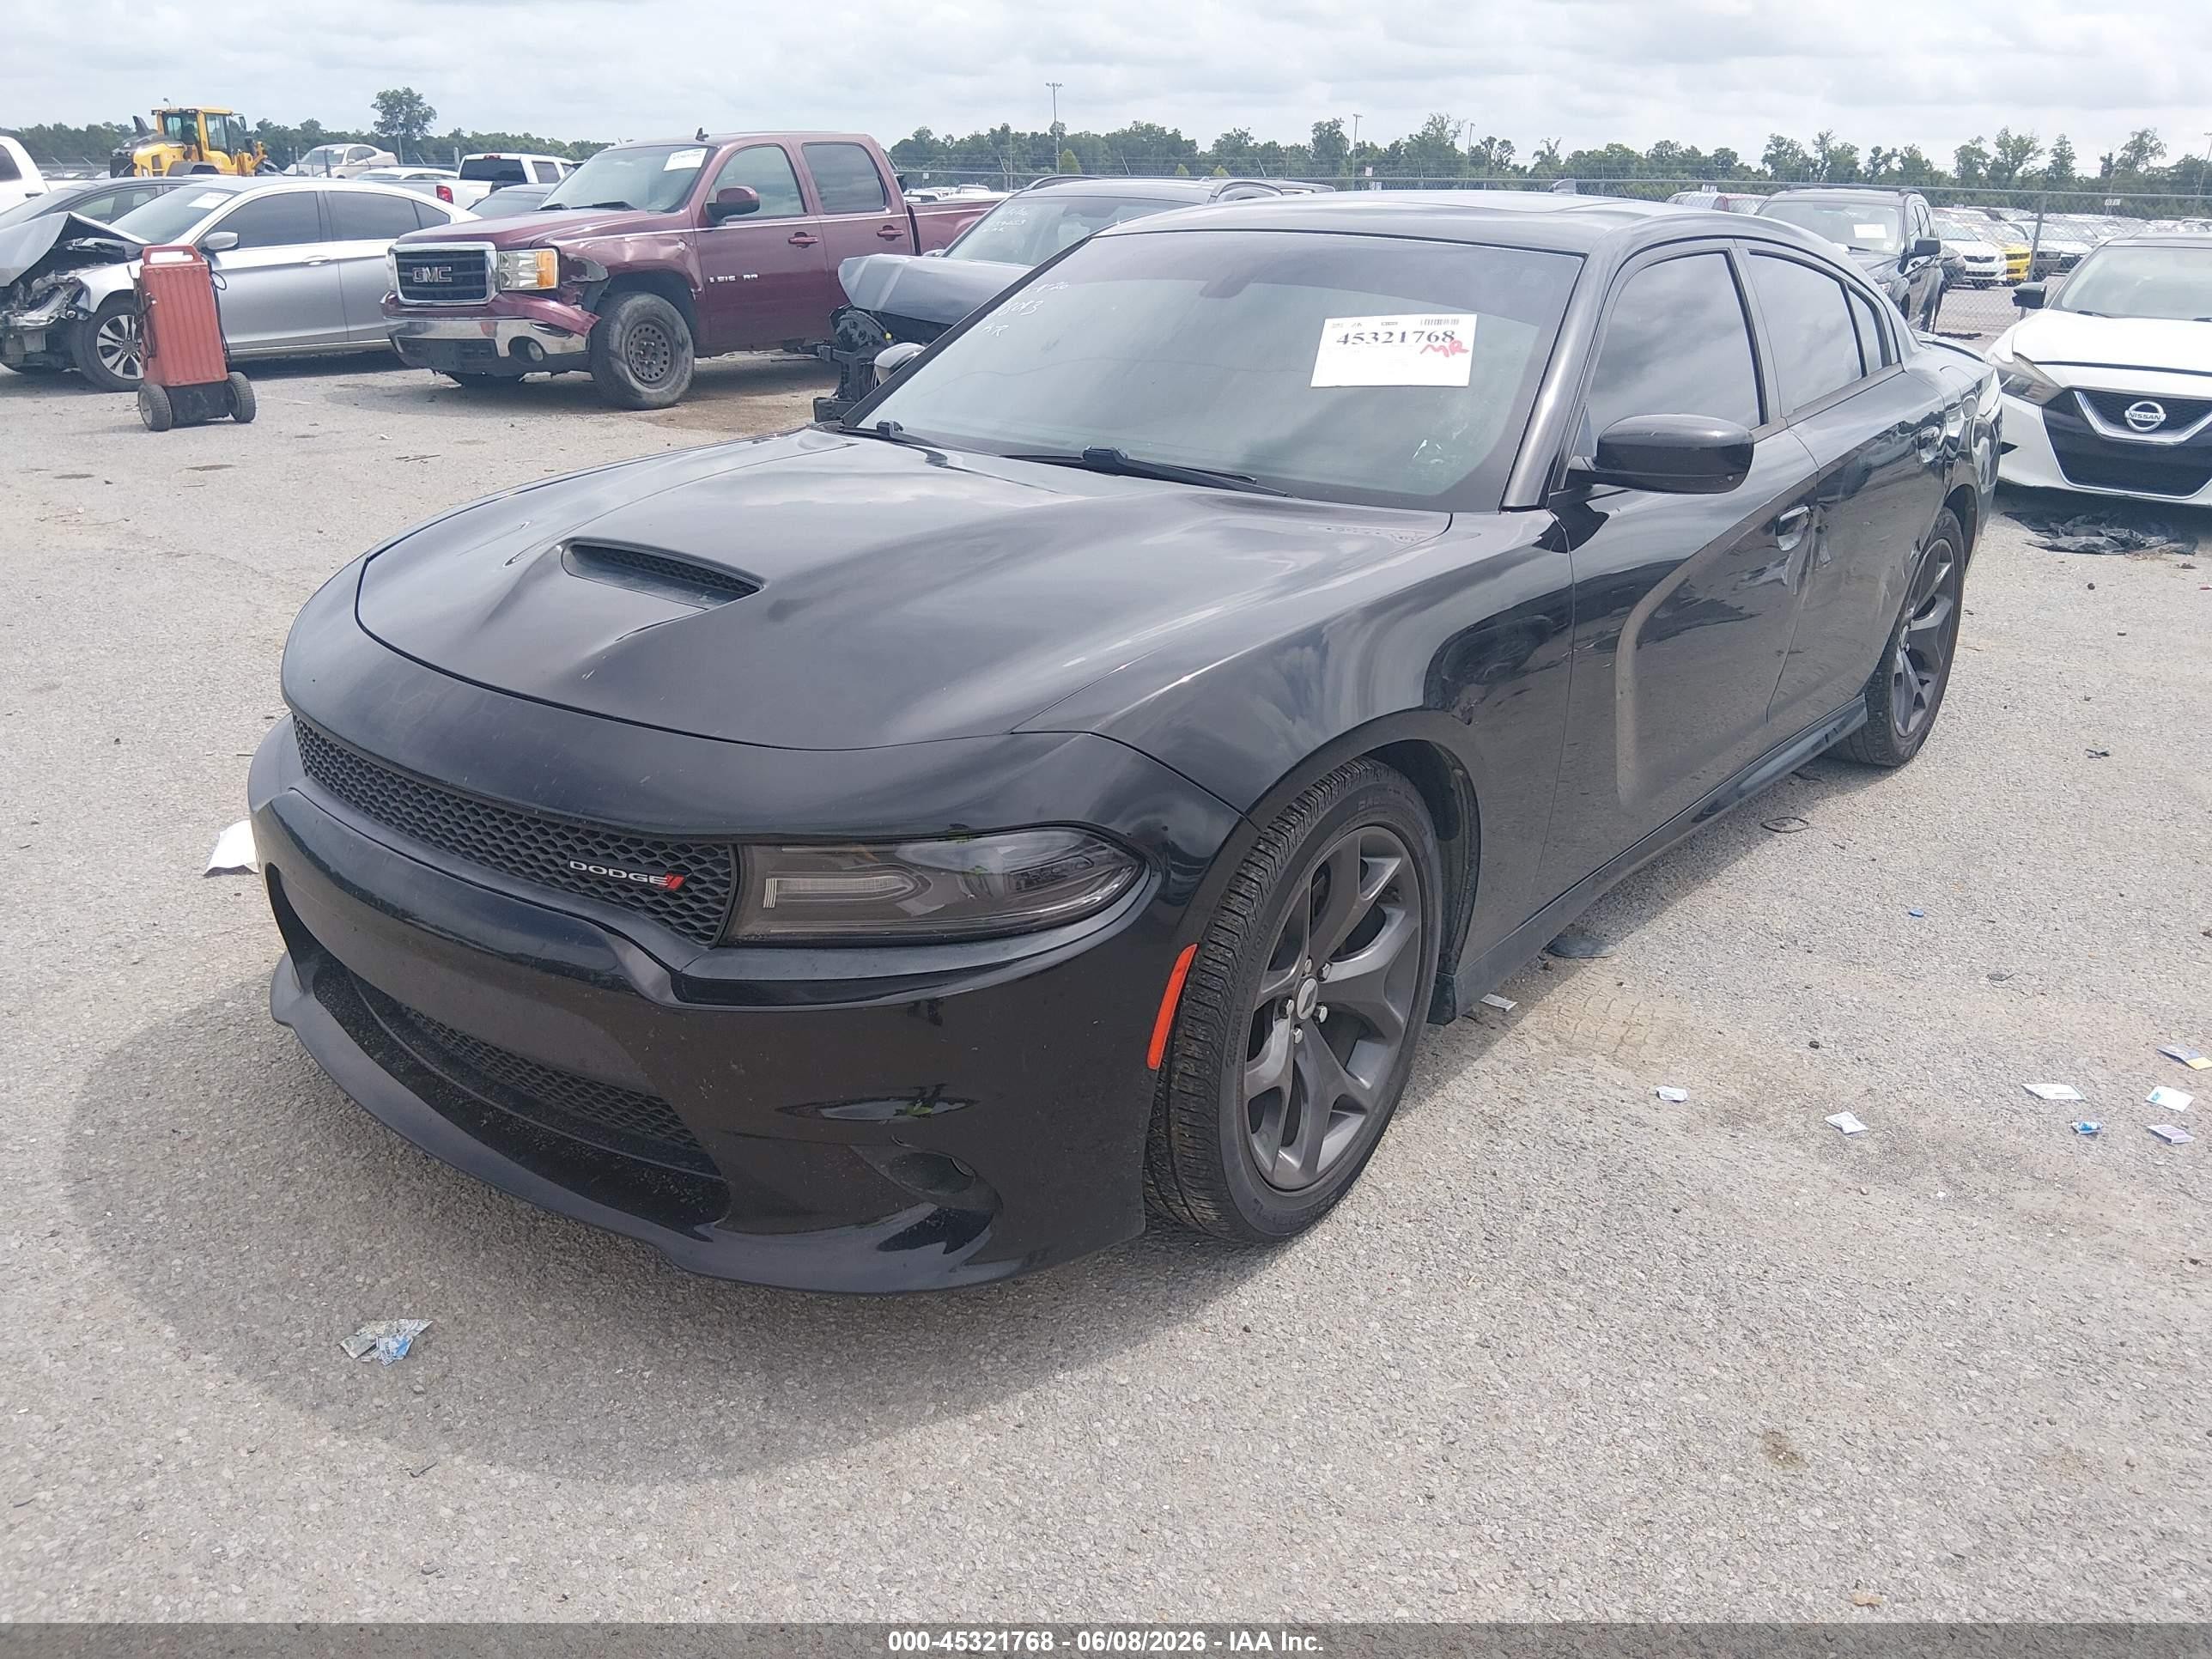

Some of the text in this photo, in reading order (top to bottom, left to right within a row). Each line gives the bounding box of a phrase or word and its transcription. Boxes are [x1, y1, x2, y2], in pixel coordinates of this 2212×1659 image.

[412, 266, 453, 283] GMC
[1336, 330, 1455, 345] 45321768
[569, 860, 669, 886] DODGE
